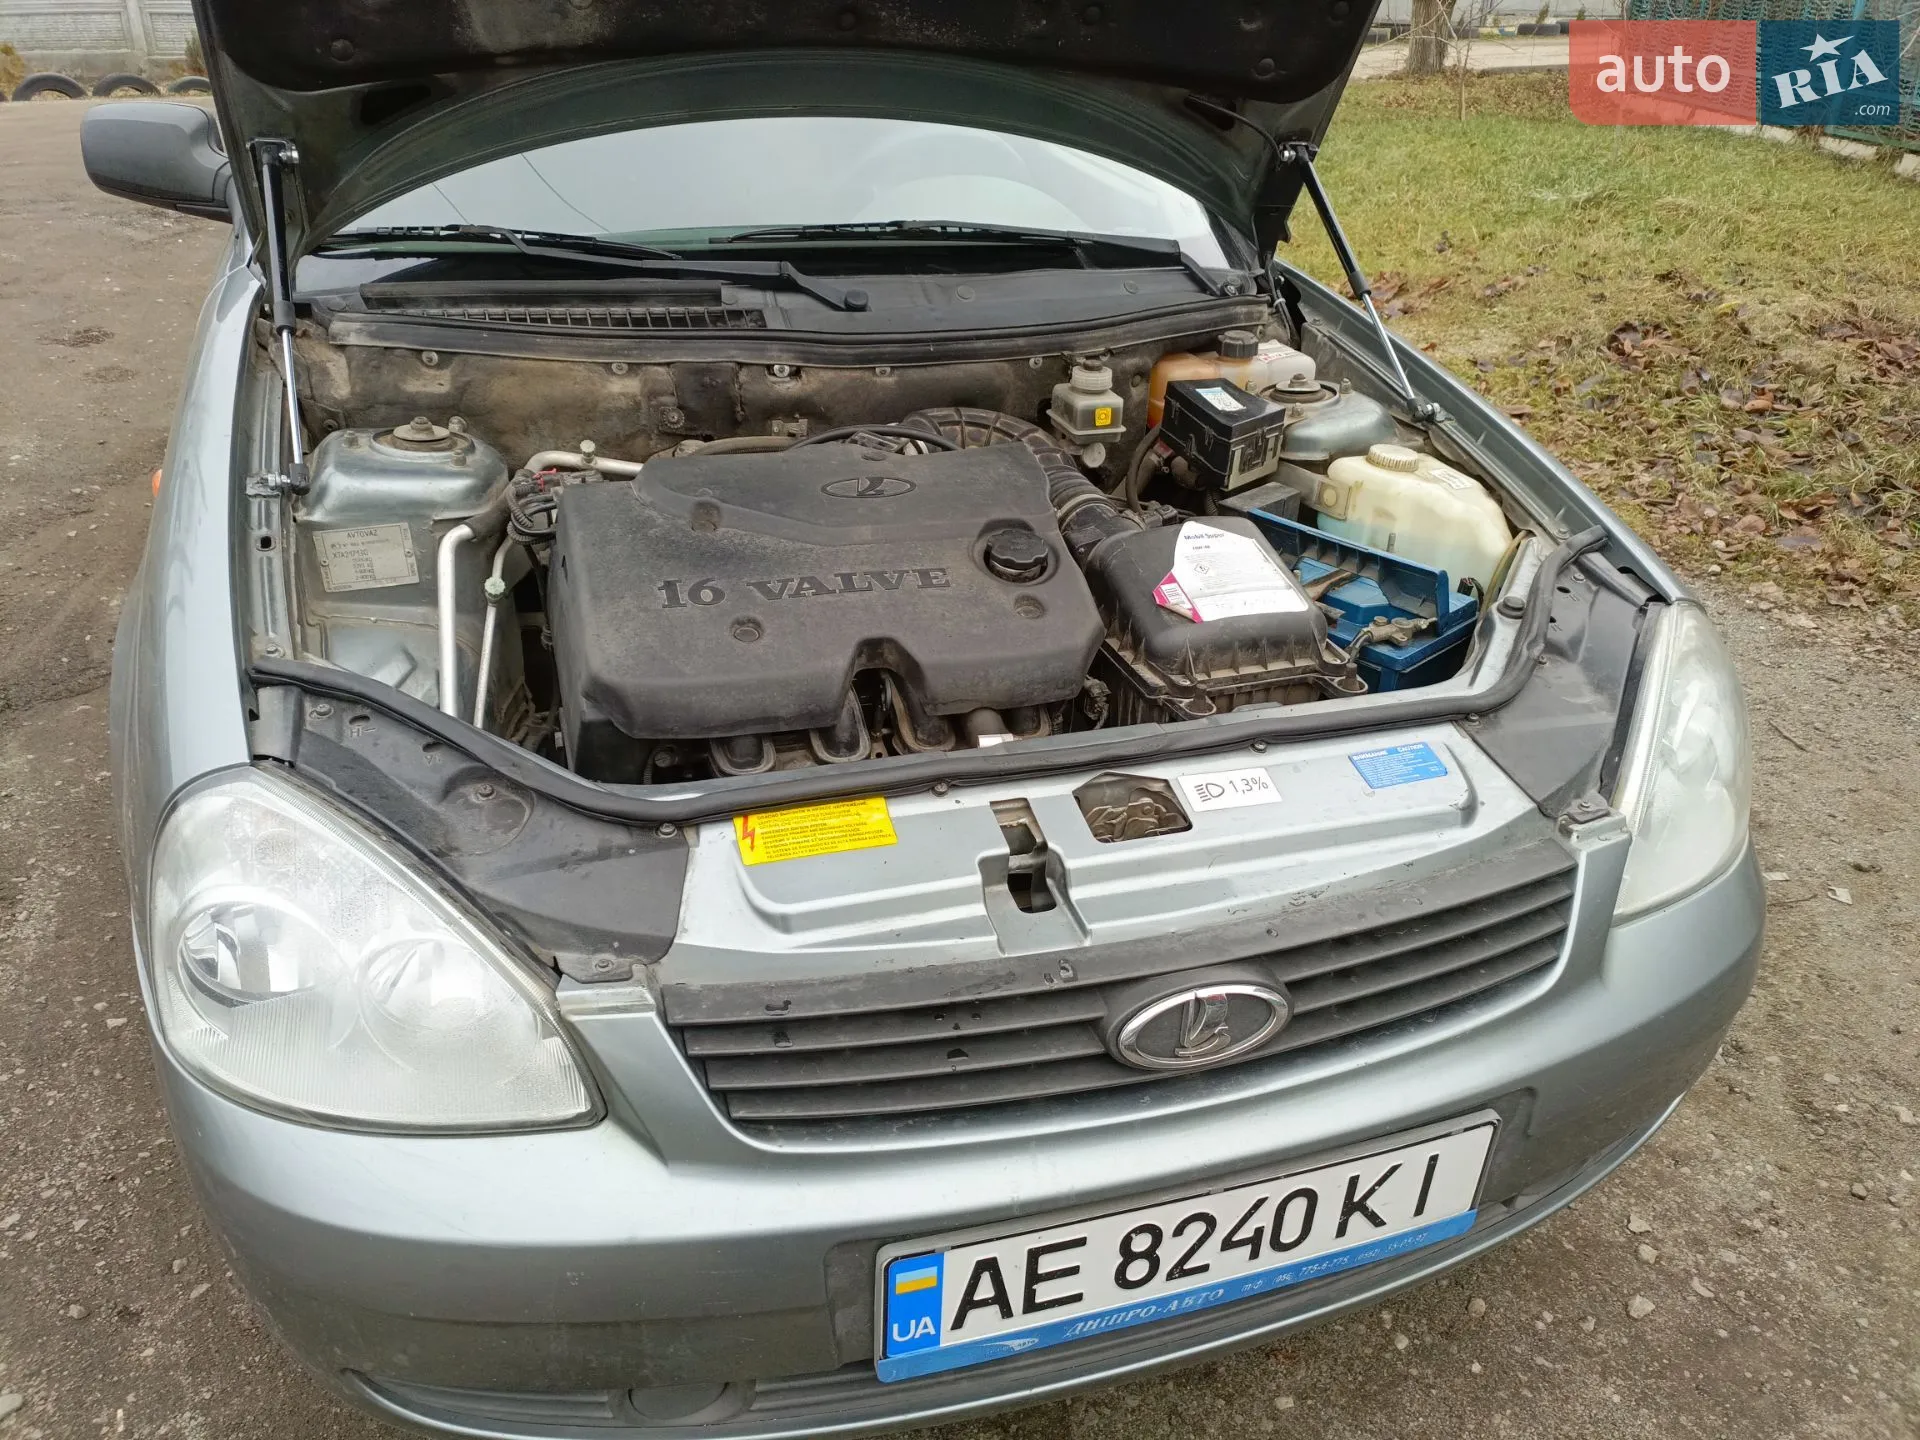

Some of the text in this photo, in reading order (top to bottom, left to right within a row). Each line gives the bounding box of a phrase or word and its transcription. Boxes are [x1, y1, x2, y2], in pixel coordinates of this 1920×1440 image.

[657, 567, 951, 609] 16 VALVE
[1228, 775, 1269, 795] 1,3%
[949, 1152, 1440, 1331] AE 8240 KI
[892, 1316, 936, 1342] UA
